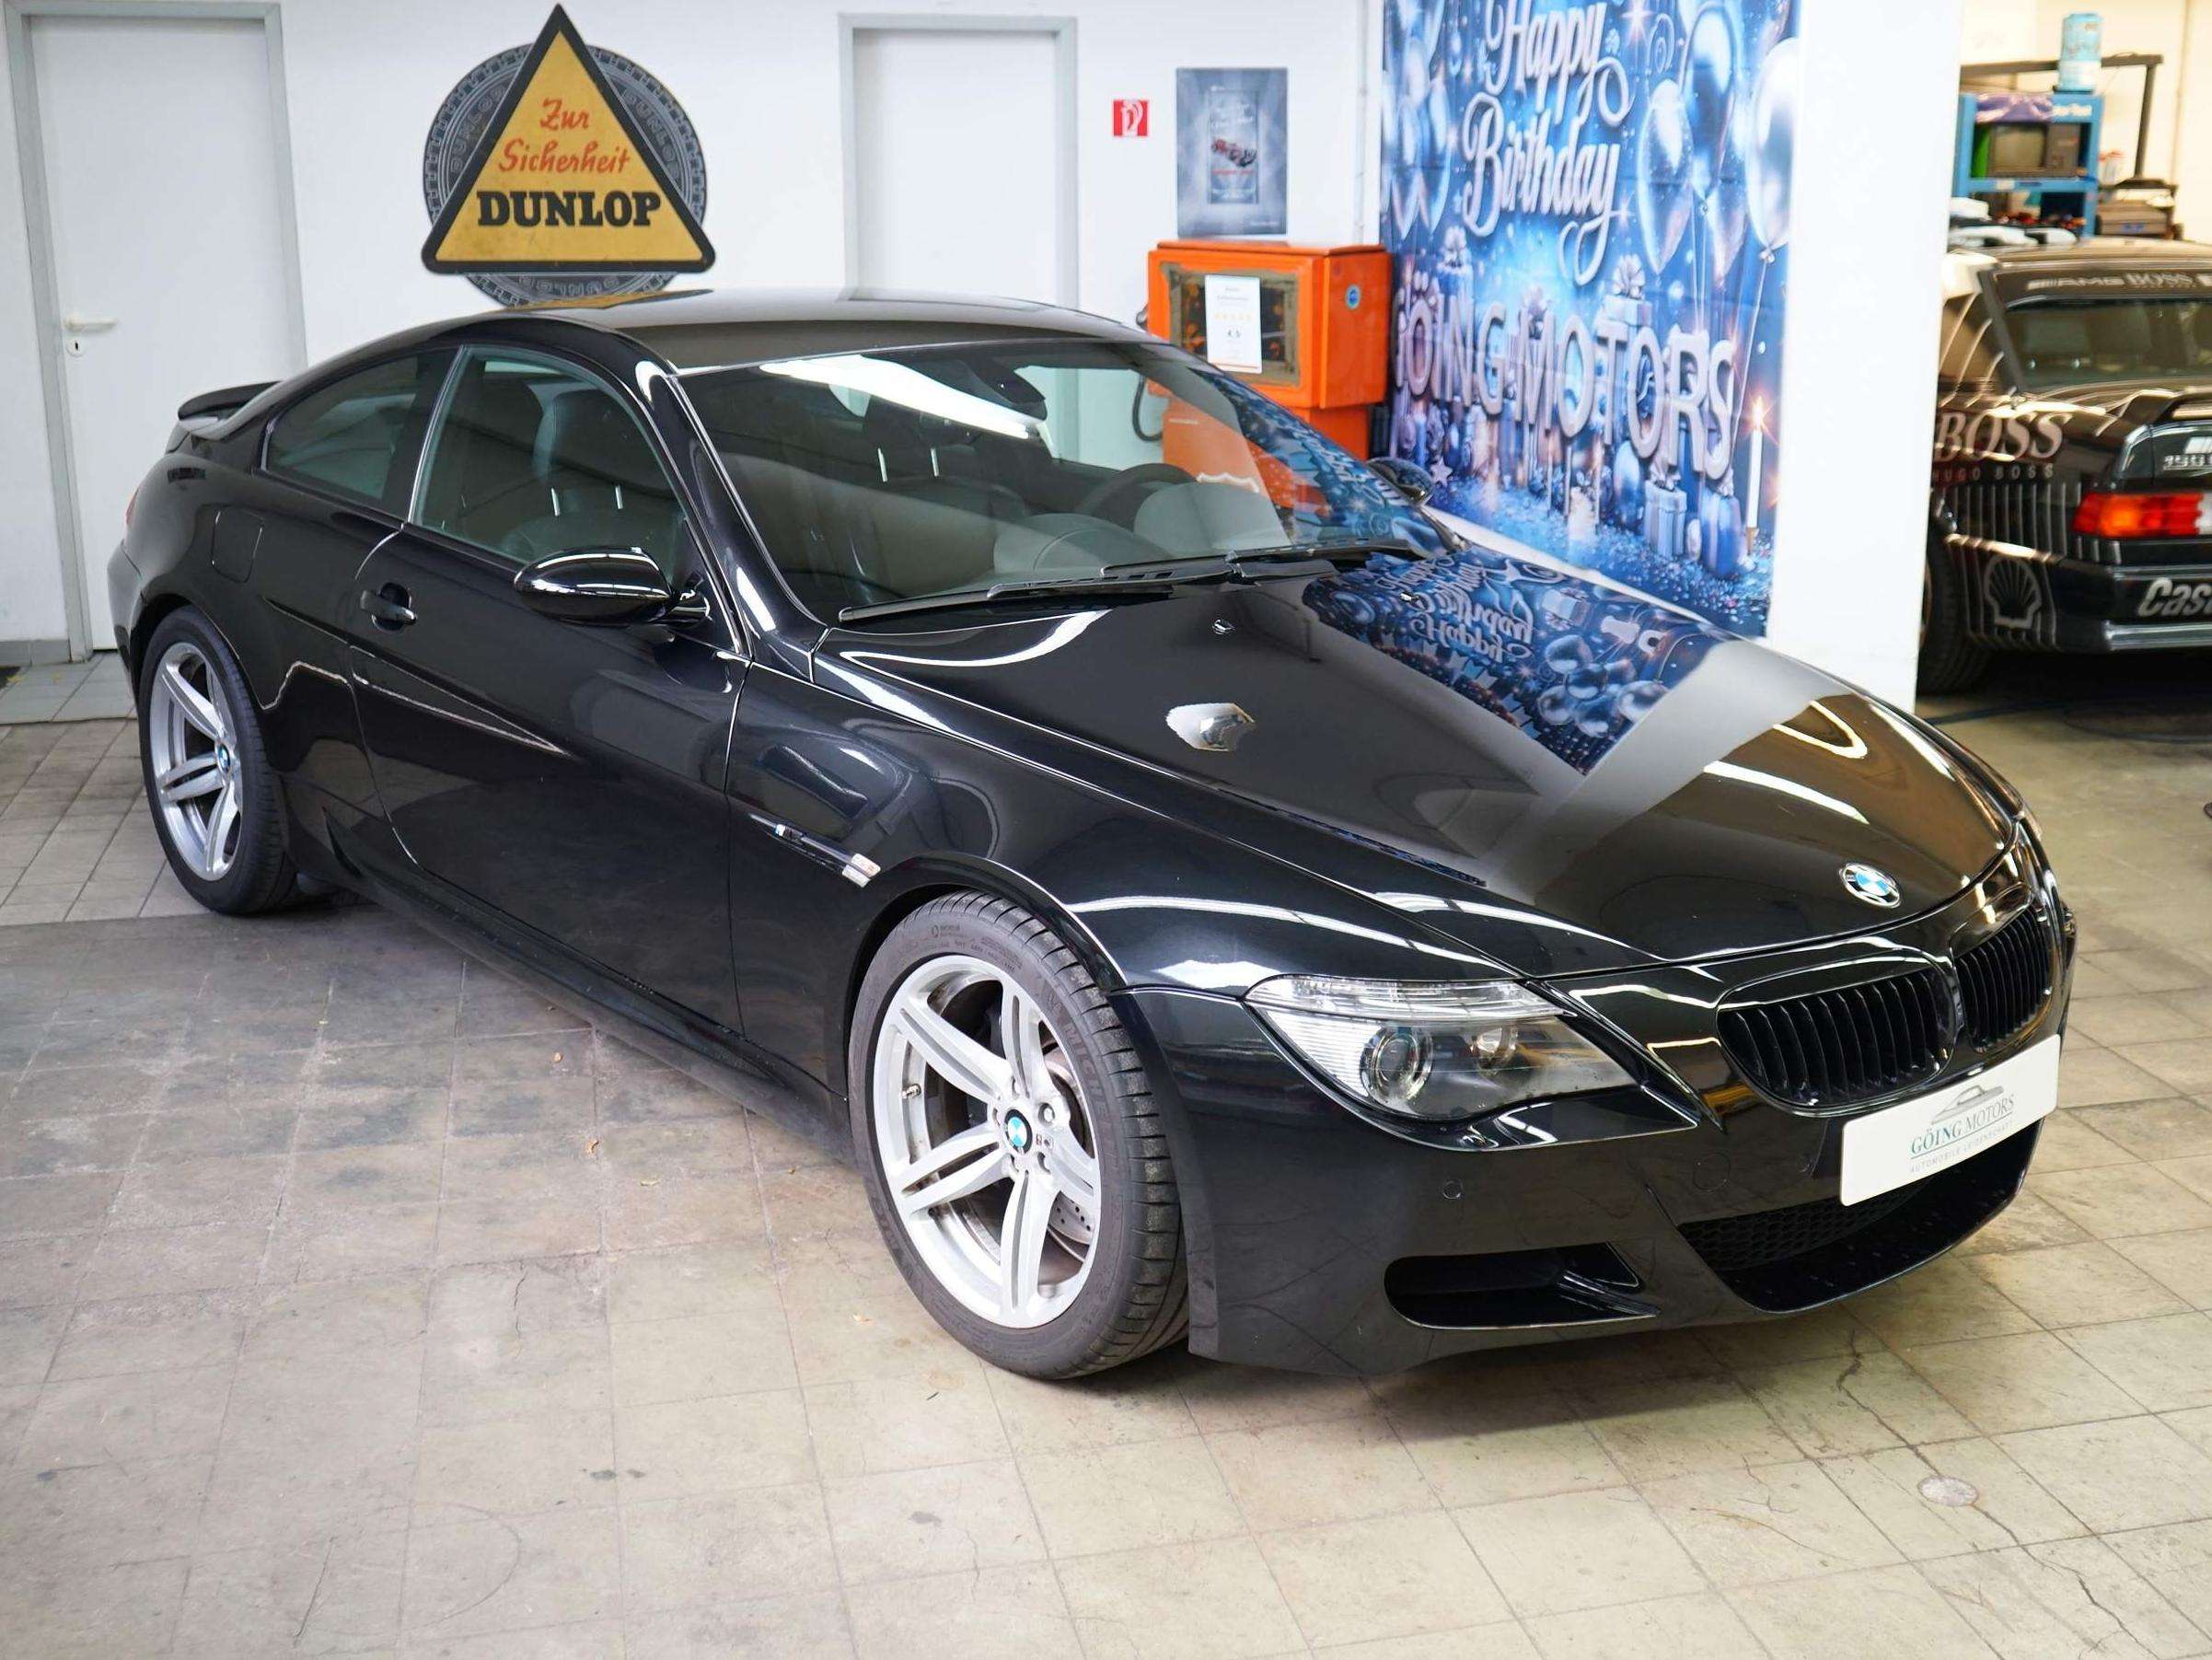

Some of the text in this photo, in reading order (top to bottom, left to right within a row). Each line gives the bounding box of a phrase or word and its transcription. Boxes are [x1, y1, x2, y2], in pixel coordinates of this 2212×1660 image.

[1485, 0, 1632, 127] Happy
[539, 98, 590, 131] Zur
[497, 137, 631, 175] Sicherheit
[476, 190, 662, 227] DUNLOP
[1462, 92, 1622, 286] Birthday
[1513, 309, 1736, 481] MOTORS
[1934, 412, 2073, 461] BOSS
[1995, 463, 2054, 481] BOSS
[2137, 577, 2212, 617] Cas
[1910, 1097, 2014, 1155] GÖING MOTORS
